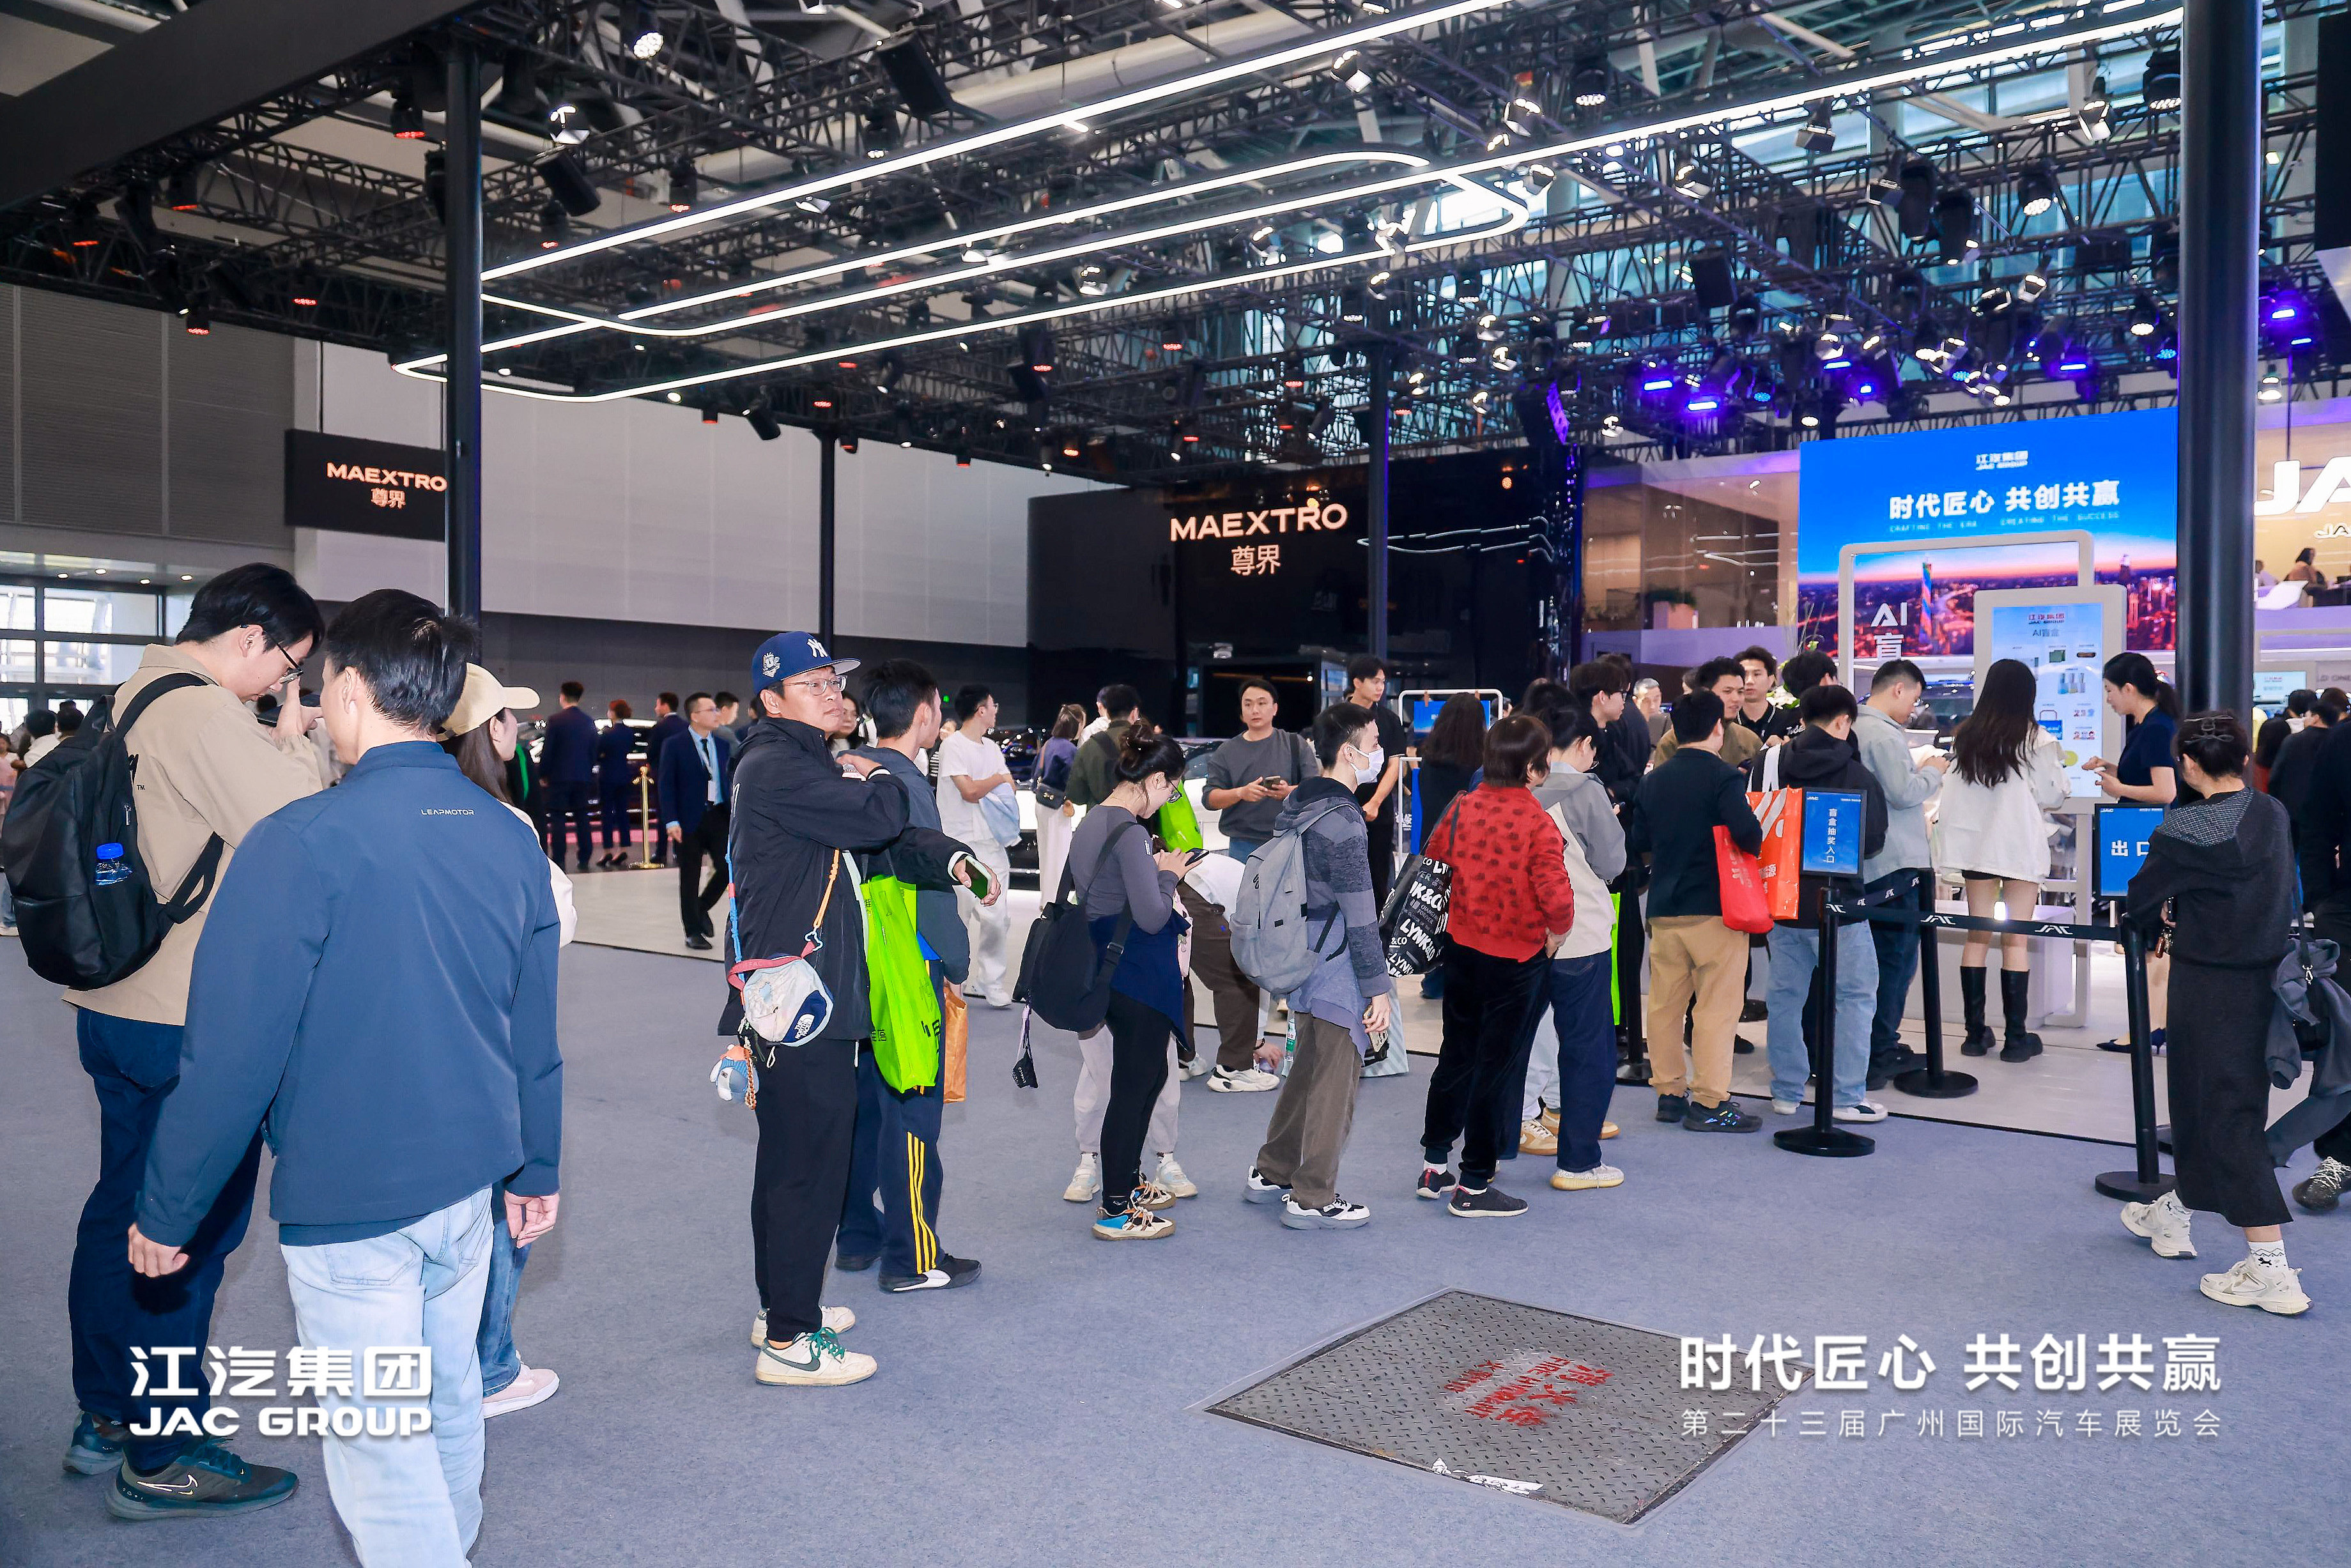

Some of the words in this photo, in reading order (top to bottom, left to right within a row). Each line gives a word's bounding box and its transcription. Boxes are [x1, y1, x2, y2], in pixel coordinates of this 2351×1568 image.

[327, 462, 448, 492] MAEXTRO
[1889, 489, 1994, 520] 时代匠心
[2005, 480, 2120, 512] 共创共赢
[1170, 503, 1348, 542] MAEXTRO
[1230, 544, 1281, 576] 尊界
[1871, 602, 1908, 627] AI
[1826, 808, 1838, 863] 盲盒抽奖入口
[2111, 840, 2150, 857] 出口
[1921, 915, 1956, 925] JAC
[2035, 925, 2074, 935] JAC
